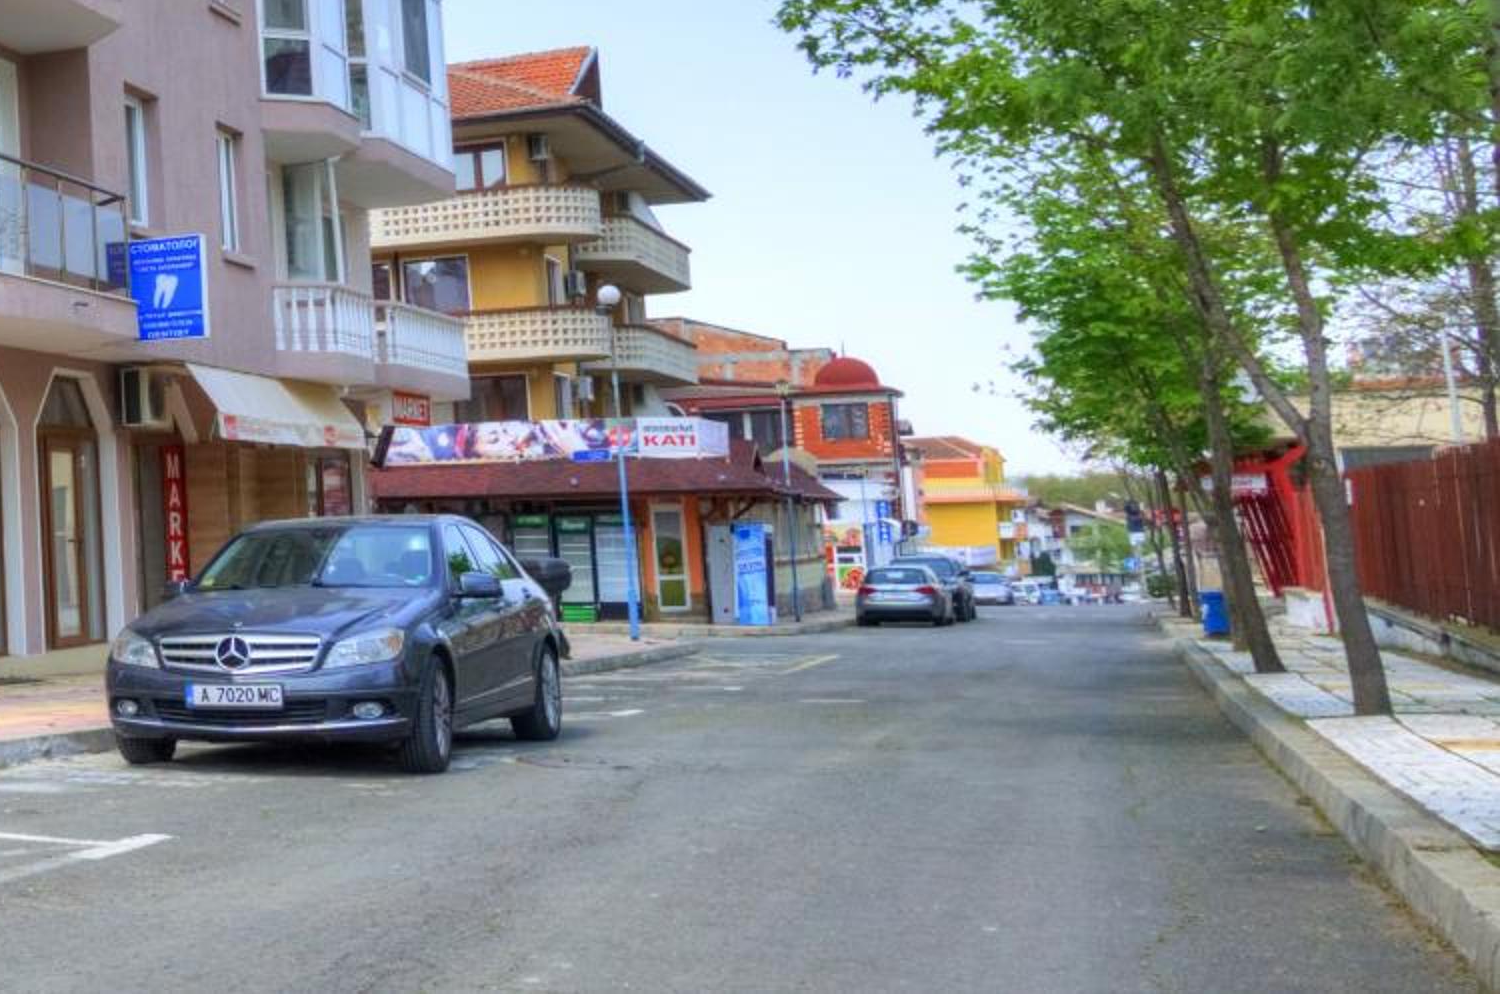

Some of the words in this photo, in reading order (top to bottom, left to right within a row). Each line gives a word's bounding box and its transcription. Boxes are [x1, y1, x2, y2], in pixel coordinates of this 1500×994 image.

[643, 434, 696, 447] KATI
[165, 452, 185, 583] MARKE
[216, 687, 255, 703] 7020
